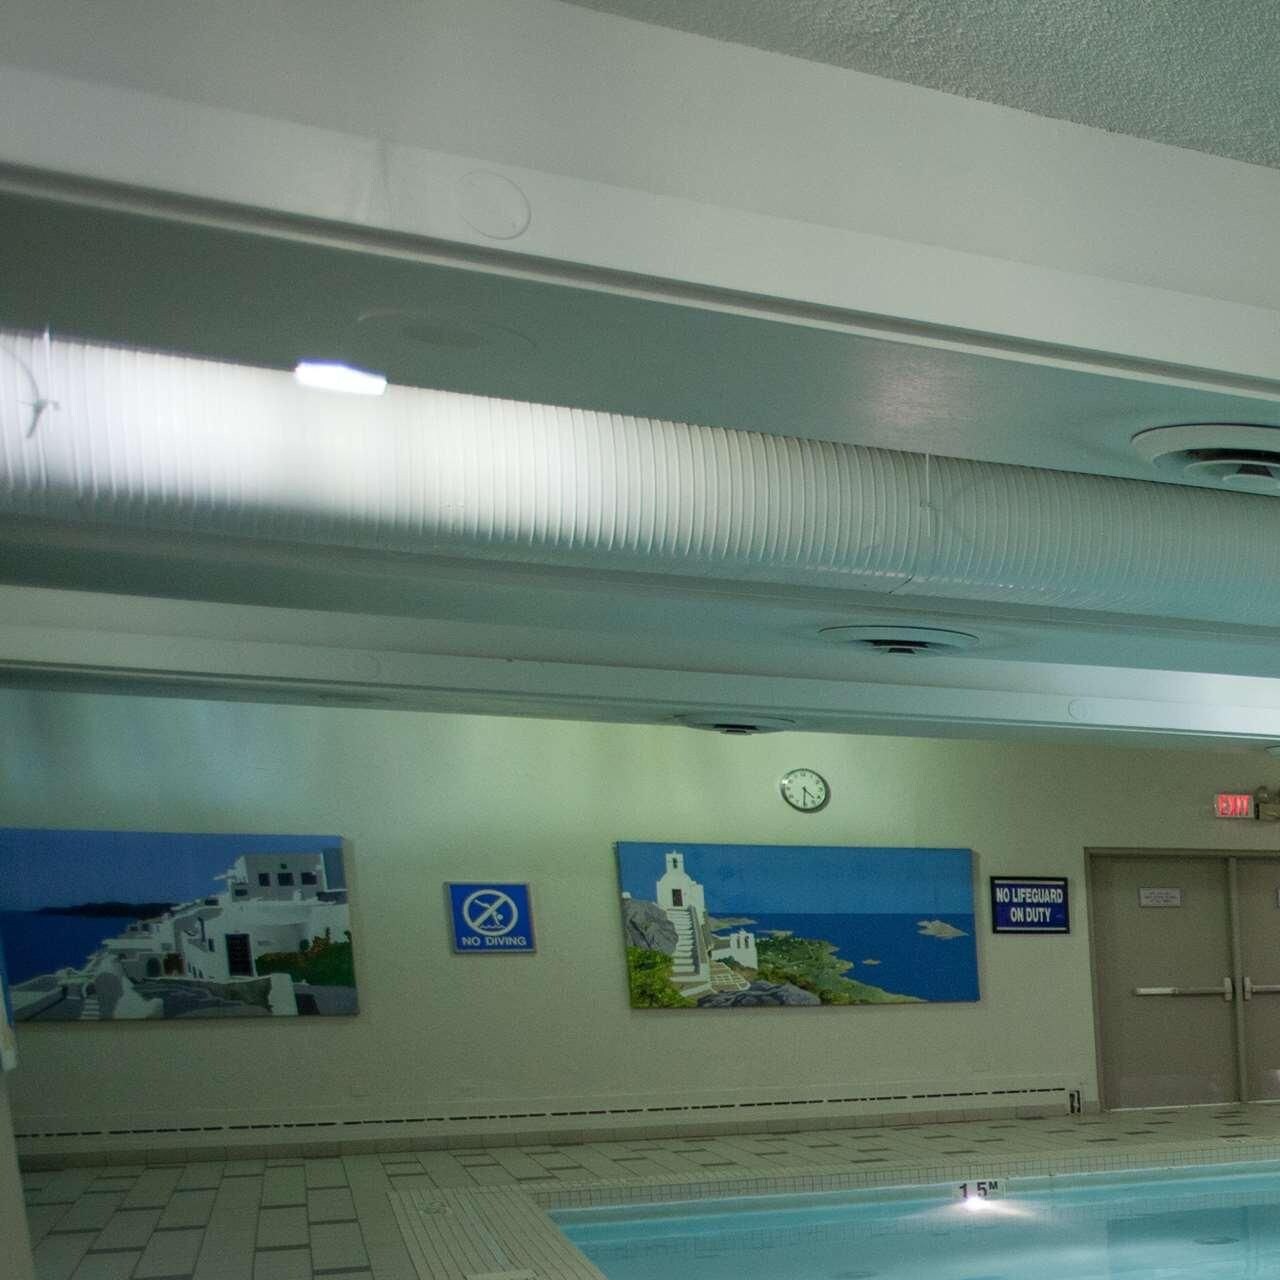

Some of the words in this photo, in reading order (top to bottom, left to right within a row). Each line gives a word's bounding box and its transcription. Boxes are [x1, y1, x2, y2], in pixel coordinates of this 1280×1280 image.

[1219, 795, 1249, 816] EXIT
[996, 888, 1010, 903] NO
[1012, 888, 1063, 903] LIFEGUARD
[1010, 907, 1024, 922] ON
[1026, 907, 1051, 922] DUTY
[461, 936, 481, 946] NO
[486, 936, 527, 946] DIVING
[959, 1180, 998, 1198] 15M
